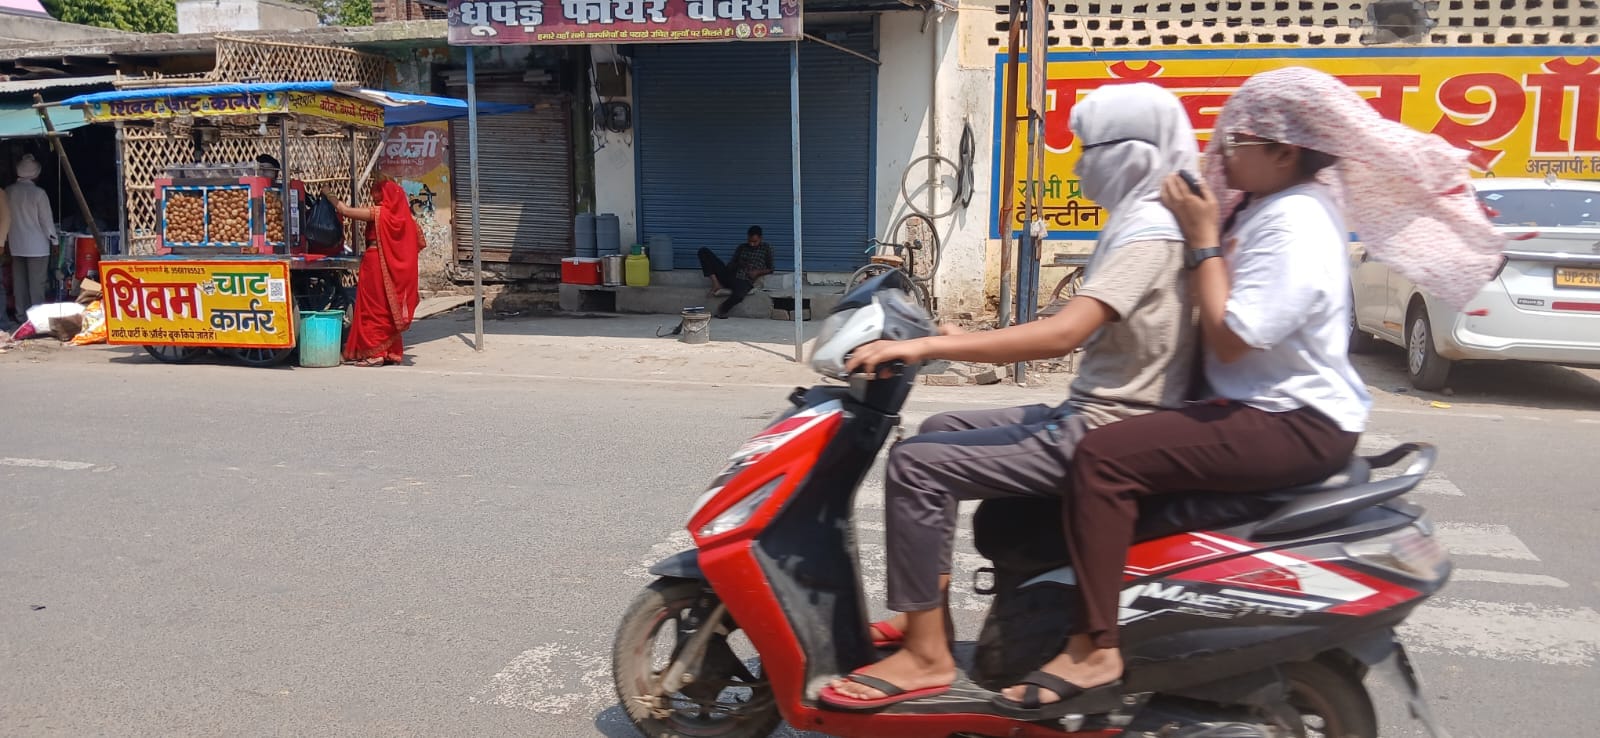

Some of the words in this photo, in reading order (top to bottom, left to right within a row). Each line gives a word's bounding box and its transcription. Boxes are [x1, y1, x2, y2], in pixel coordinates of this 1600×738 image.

[106, 268, 201, 320] शिवम
[212, 272, 270, 296] चाट
[210, 298, 275, 333] कार्नर
